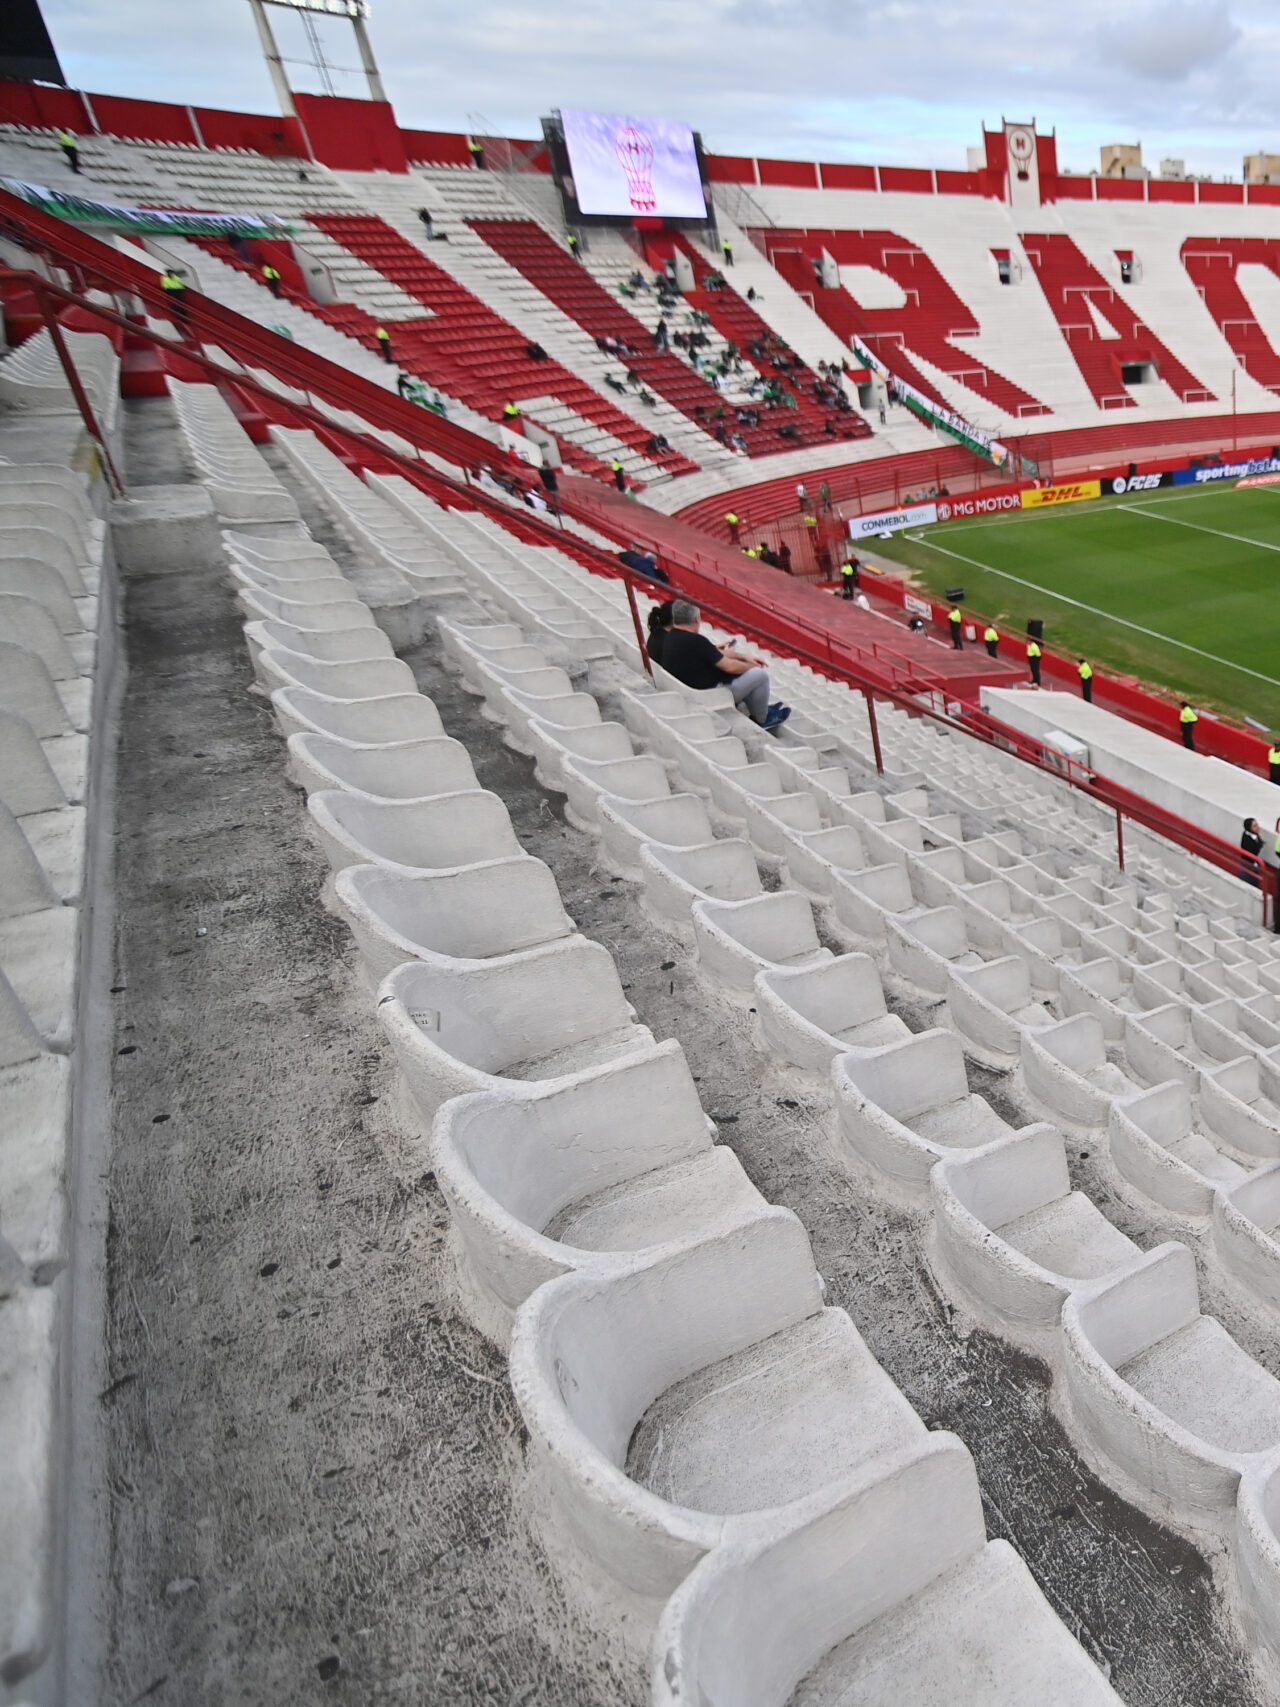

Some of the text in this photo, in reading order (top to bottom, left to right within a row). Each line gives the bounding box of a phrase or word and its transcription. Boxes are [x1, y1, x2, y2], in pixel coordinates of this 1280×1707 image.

[628, 142, 640, 155] H
[1016, 138, 1025, 151] H
[948, 413, 980, 440] BANDA
[1041, 486, 1083, 503] DHL
[953, 501, 974, 517] MG
[975, 493, 1021, 514] MOTOR
